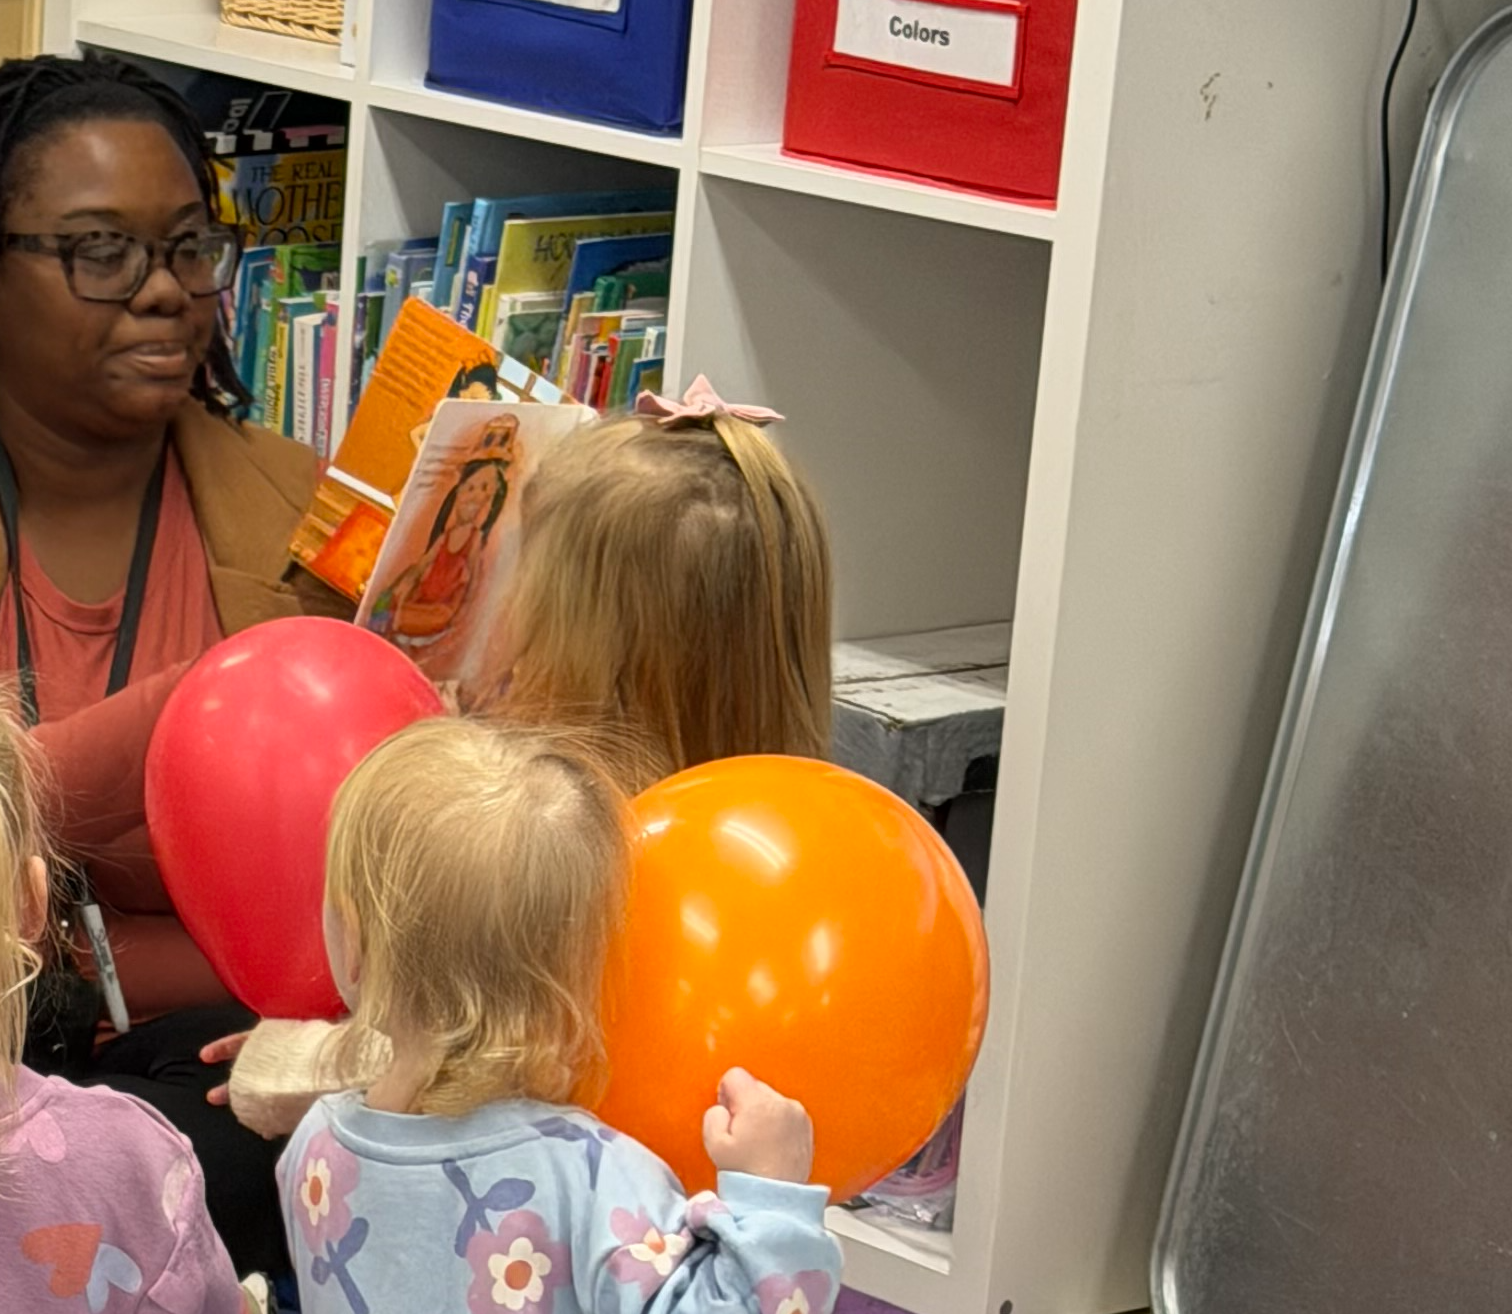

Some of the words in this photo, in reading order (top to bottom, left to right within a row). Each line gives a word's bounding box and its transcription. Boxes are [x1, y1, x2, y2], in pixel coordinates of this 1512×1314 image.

[889, 15, 950, 46] Colors
[251, 164, 282, 183] THE
[291, 161, 339, 181] REAL
[231, 181, 342, 227] MOTHE
